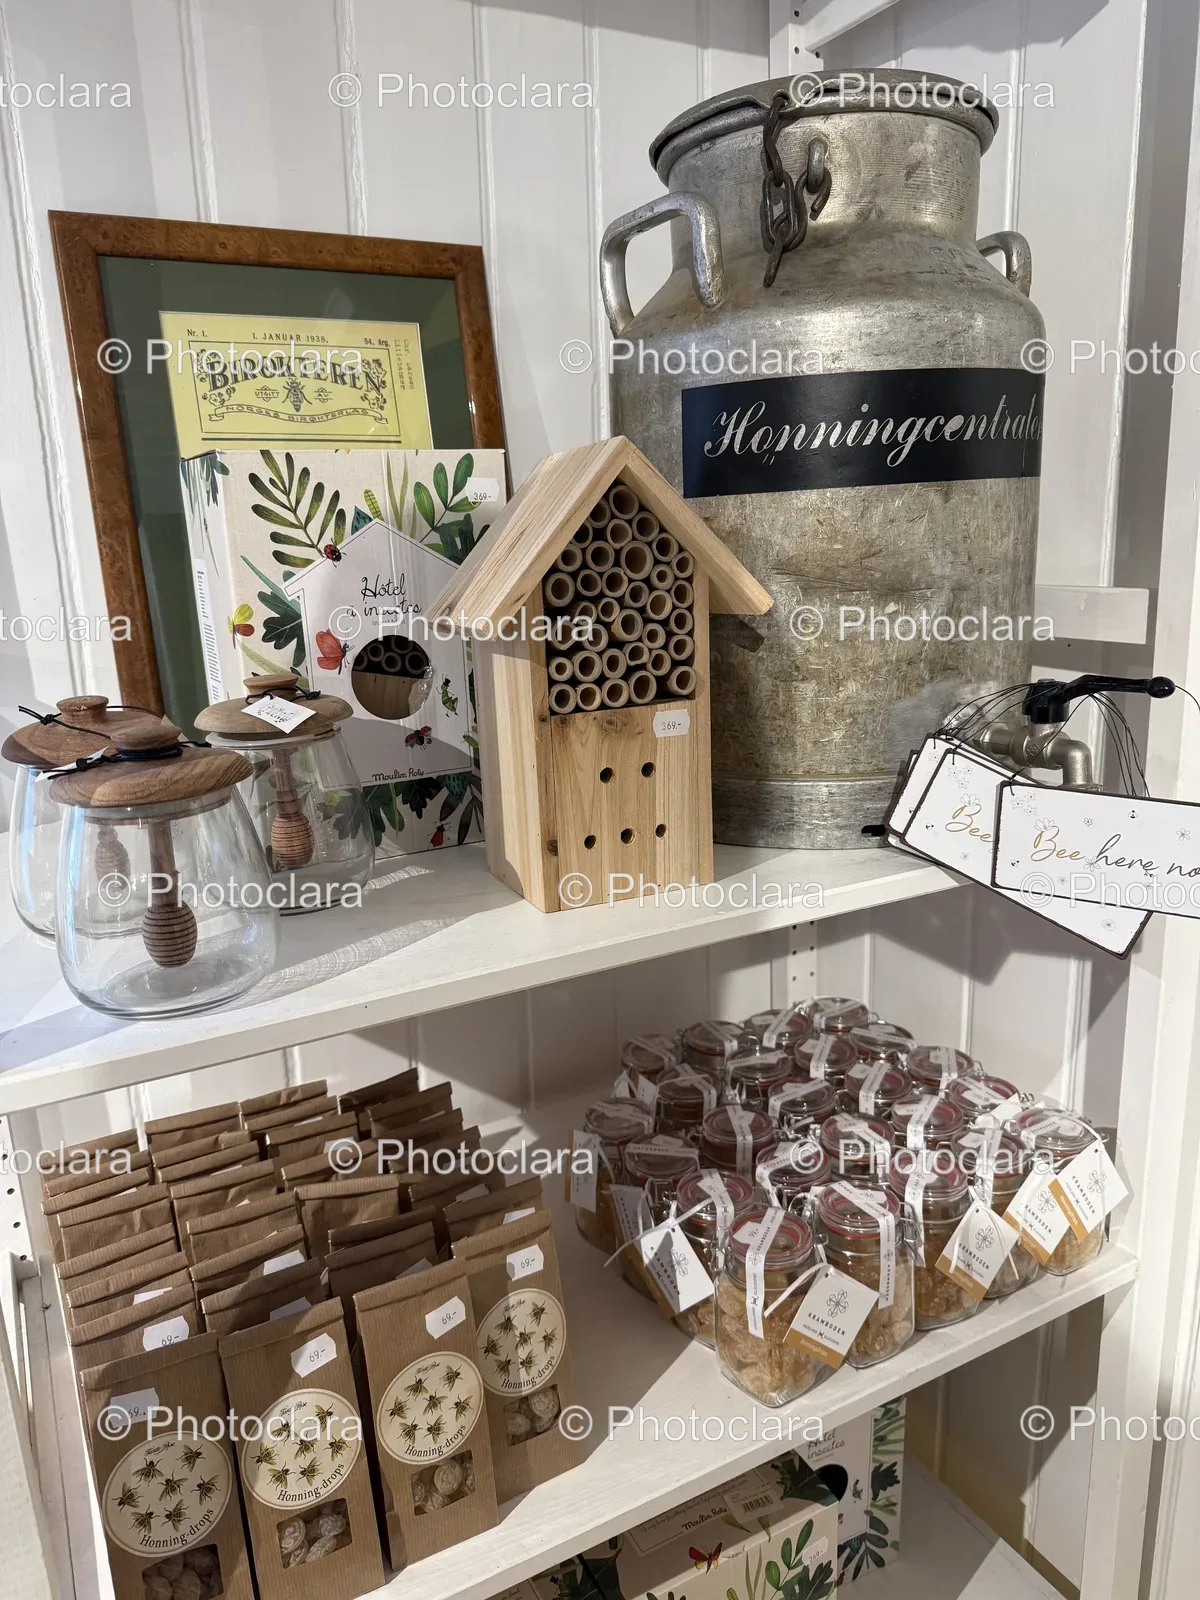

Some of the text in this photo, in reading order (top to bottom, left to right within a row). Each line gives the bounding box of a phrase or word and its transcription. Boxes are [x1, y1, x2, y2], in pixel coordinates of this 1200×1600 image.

[187, 328, 199, 337] Nr.
[263, 332, 302, 342] JANUAR
[306, 334, 329, 343] 1938.
[364, 338, 376, 346] 54.
[226, 406, 369, 423] NORGES BIRØKTERLAG
[361, 572, 406, 601] Hôtel
[364, 596, 422, 617] inectes
[660, 720, 682, 731] 369.-
[372, 766, 425, 783] Moulin Roty
[945, 803, 996, 843] Bee
[1030, 825, 1085, 862] Bee
[1094, 833, 1160, 872] here
[1071, 1175, 1096, 1215] KRAMBODEN
[1021, 1202, 1053, 1235] RAMBODEN
[519, 1257, 536, 1269] 69.-
[441, 1310, 458, 1325] 69.-
[807, 1312, 846, 1336] KRAMBODEN
[308, 1348, 326, 1363] 69.-
[501, 1354, 556, 1390] Honning-drops
[404, 1423, 466, 1458] Honning-drops
[277, 1463, 345, 1503] Honning-drops
[139, 1507, 215, 1549] Honning-drops
[682, 1511, 711, 1531] Moulin
